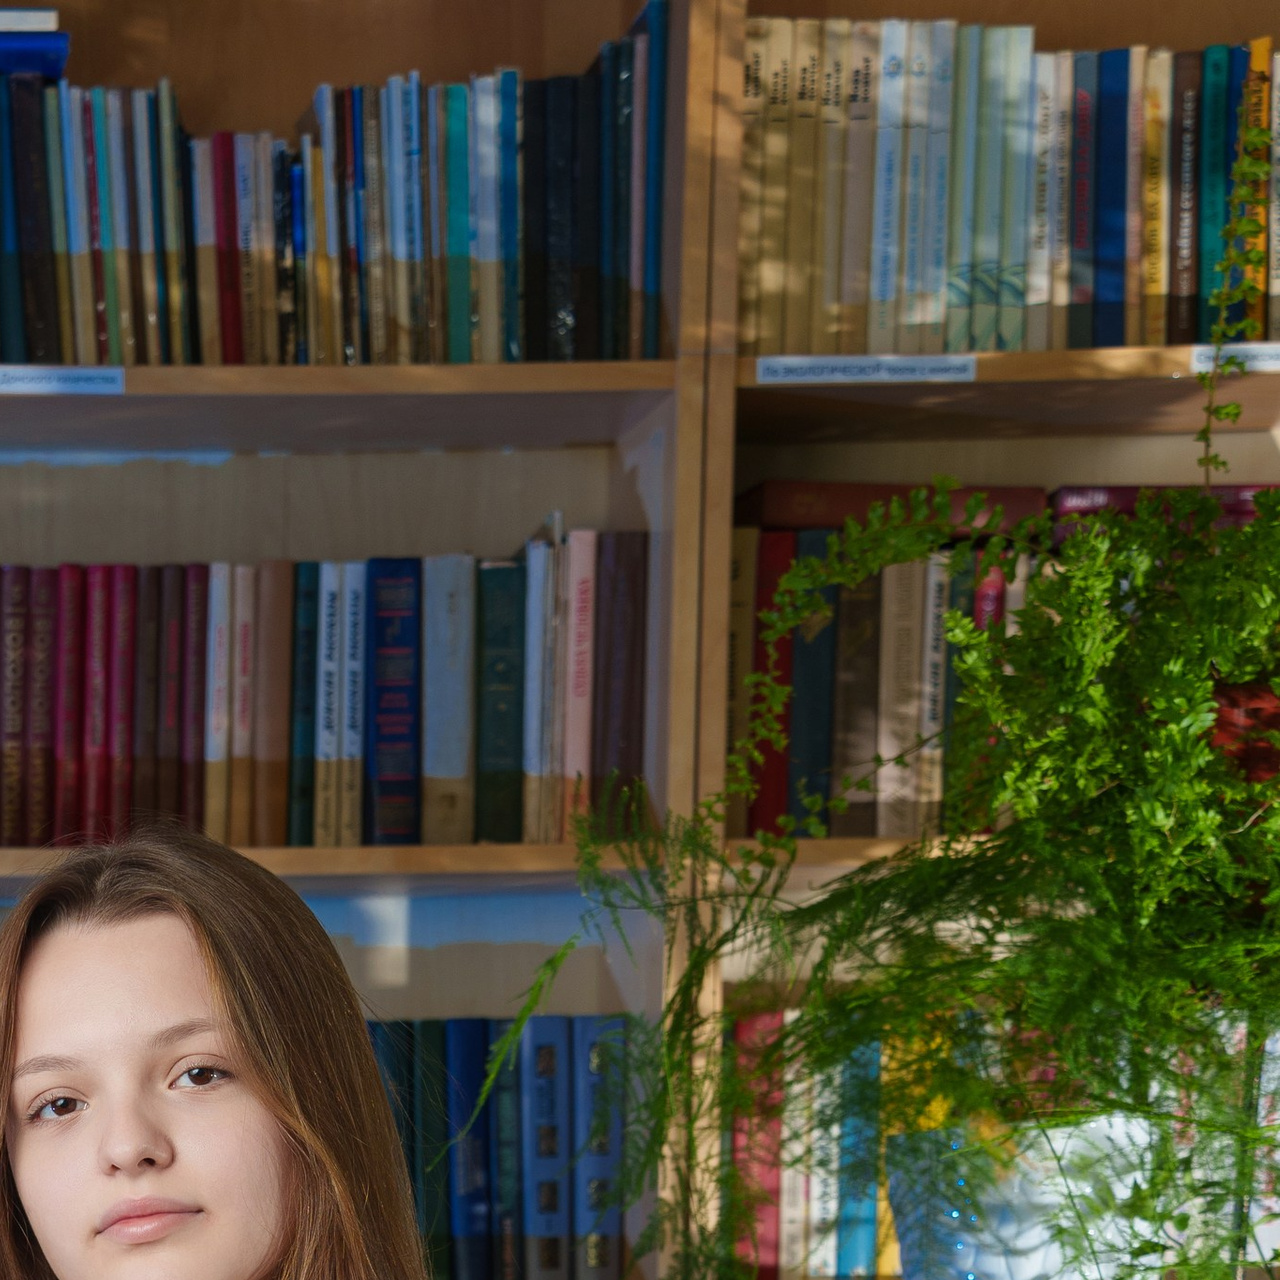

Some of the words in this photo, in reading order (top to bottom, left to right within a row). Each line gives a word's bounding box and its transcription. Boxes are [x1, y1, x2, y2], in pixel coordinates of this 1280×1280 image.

[0, 373, 53, 387] Донского
[55, 373, 117, 386] казачества
[781, 364, 882, 379] ЭКОЛОГИЧЕСКОЙ
[323, 591, 339, 662] РАССКАЗЫ
[348, 591, 361, 662] РАССКАЗЫ
[5, 617, 22, 734] ШОЛОХОВ
[33, 617, 49, 734] ШОЛОХОВ
[322, 665, 338, 735] ДОНСКИЕ
[348, 665, 361, 735] ДОНСКИЕ
